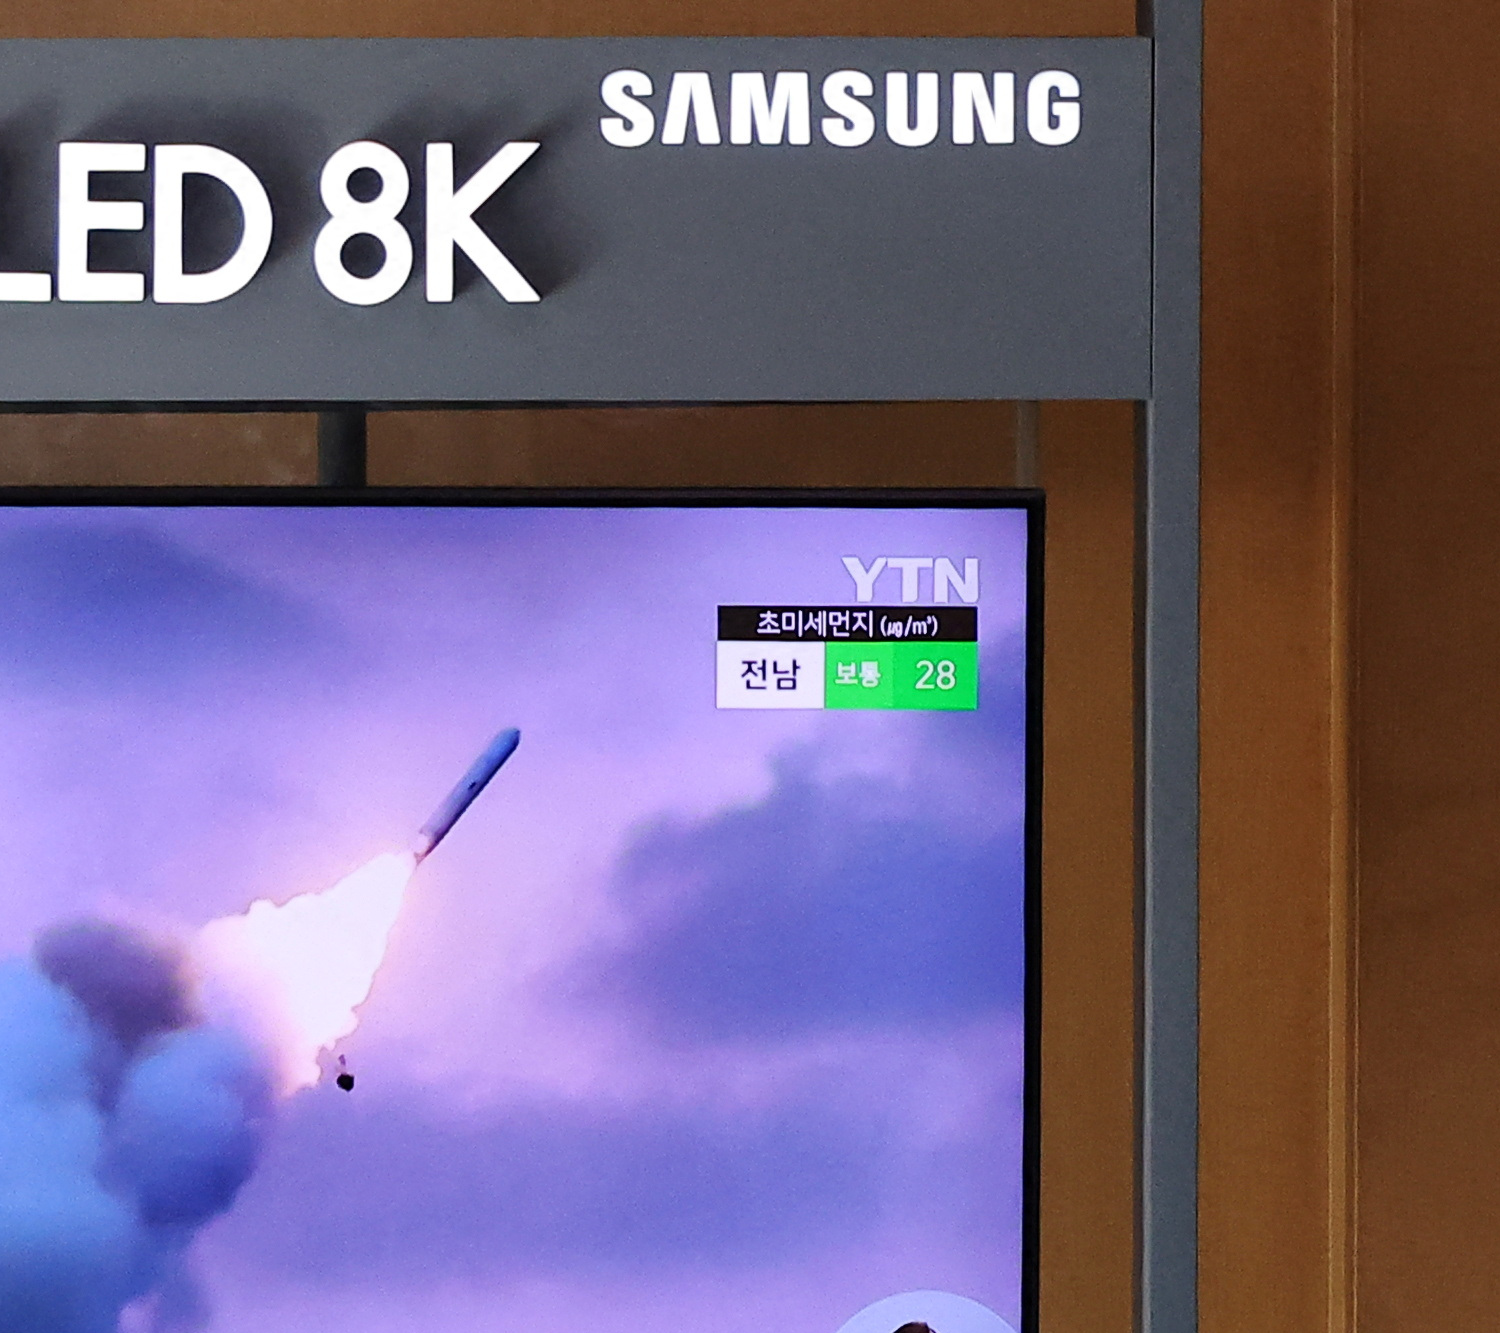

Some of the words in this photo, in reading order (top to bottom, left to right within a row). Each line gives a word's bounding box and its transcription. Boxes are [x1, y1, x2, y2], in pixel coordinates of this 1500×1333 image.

[600, 69, 1081, 147] SAMSUNG
[313, 139, 542, 305] 8K
[842, 557, 980, 603] YTN
[757, 610, 874, 637] 초미세먼지
[741, 659, 801, 690] 전남
[915, 660, 956, 690] 28
